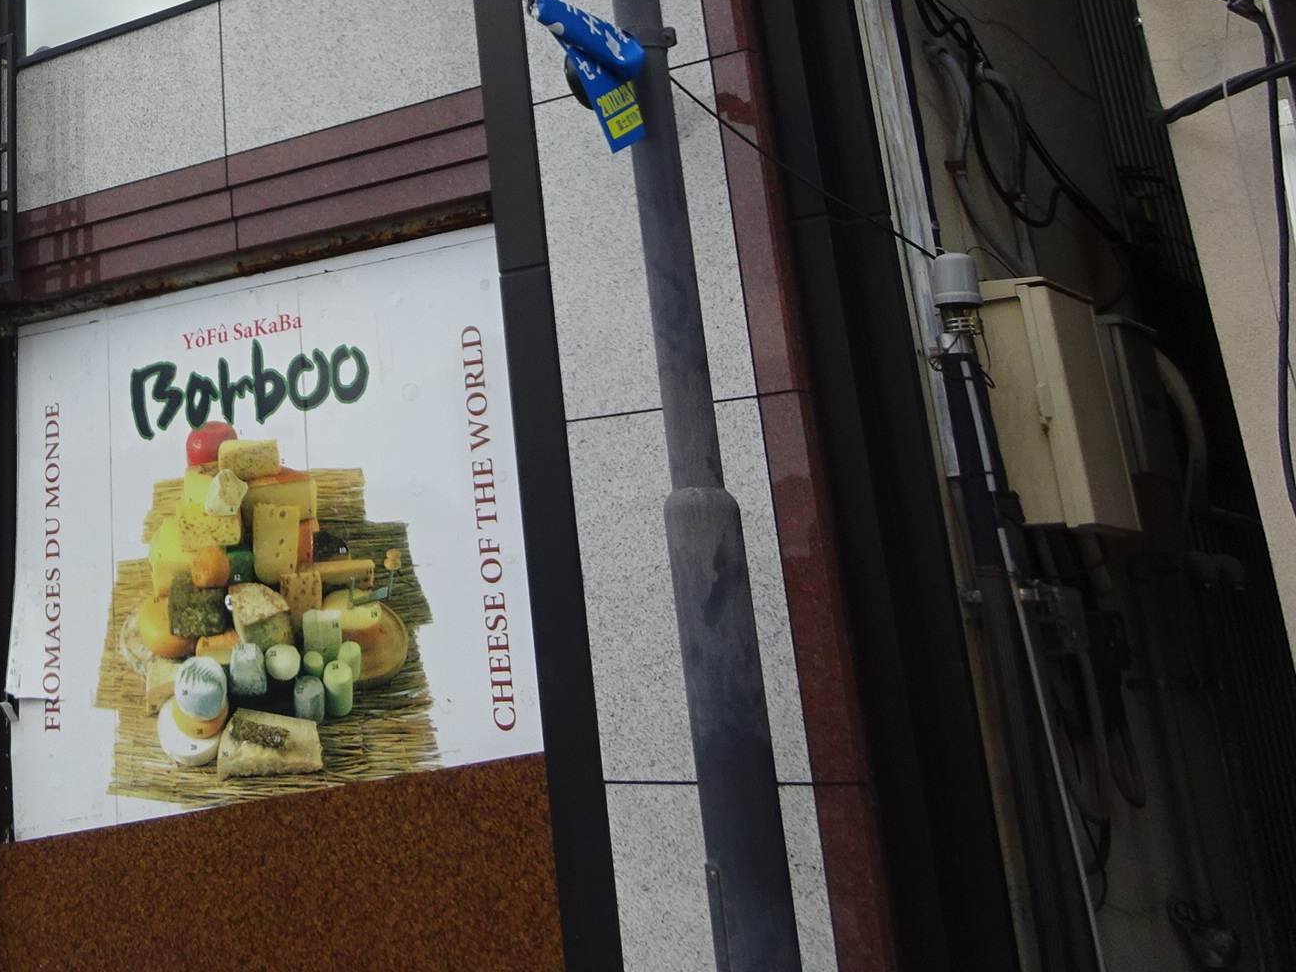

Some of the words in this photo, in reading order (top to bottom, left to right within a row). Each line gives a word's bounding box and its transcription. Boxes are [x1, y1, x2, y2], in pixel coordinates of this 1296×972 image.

[232, 313, 303, 341] SaKaBa
[461, 325, 490, 452] WORLD
[45, 402, 61, 509] MONDE
[471, 457, 499, 530] THE
[45, 517, 61, 560] DU
[479, 536, 504, 584] OF
[42, 567, 61, 732] FROMAGES
[482, 591, 517, 732] CHEESE
